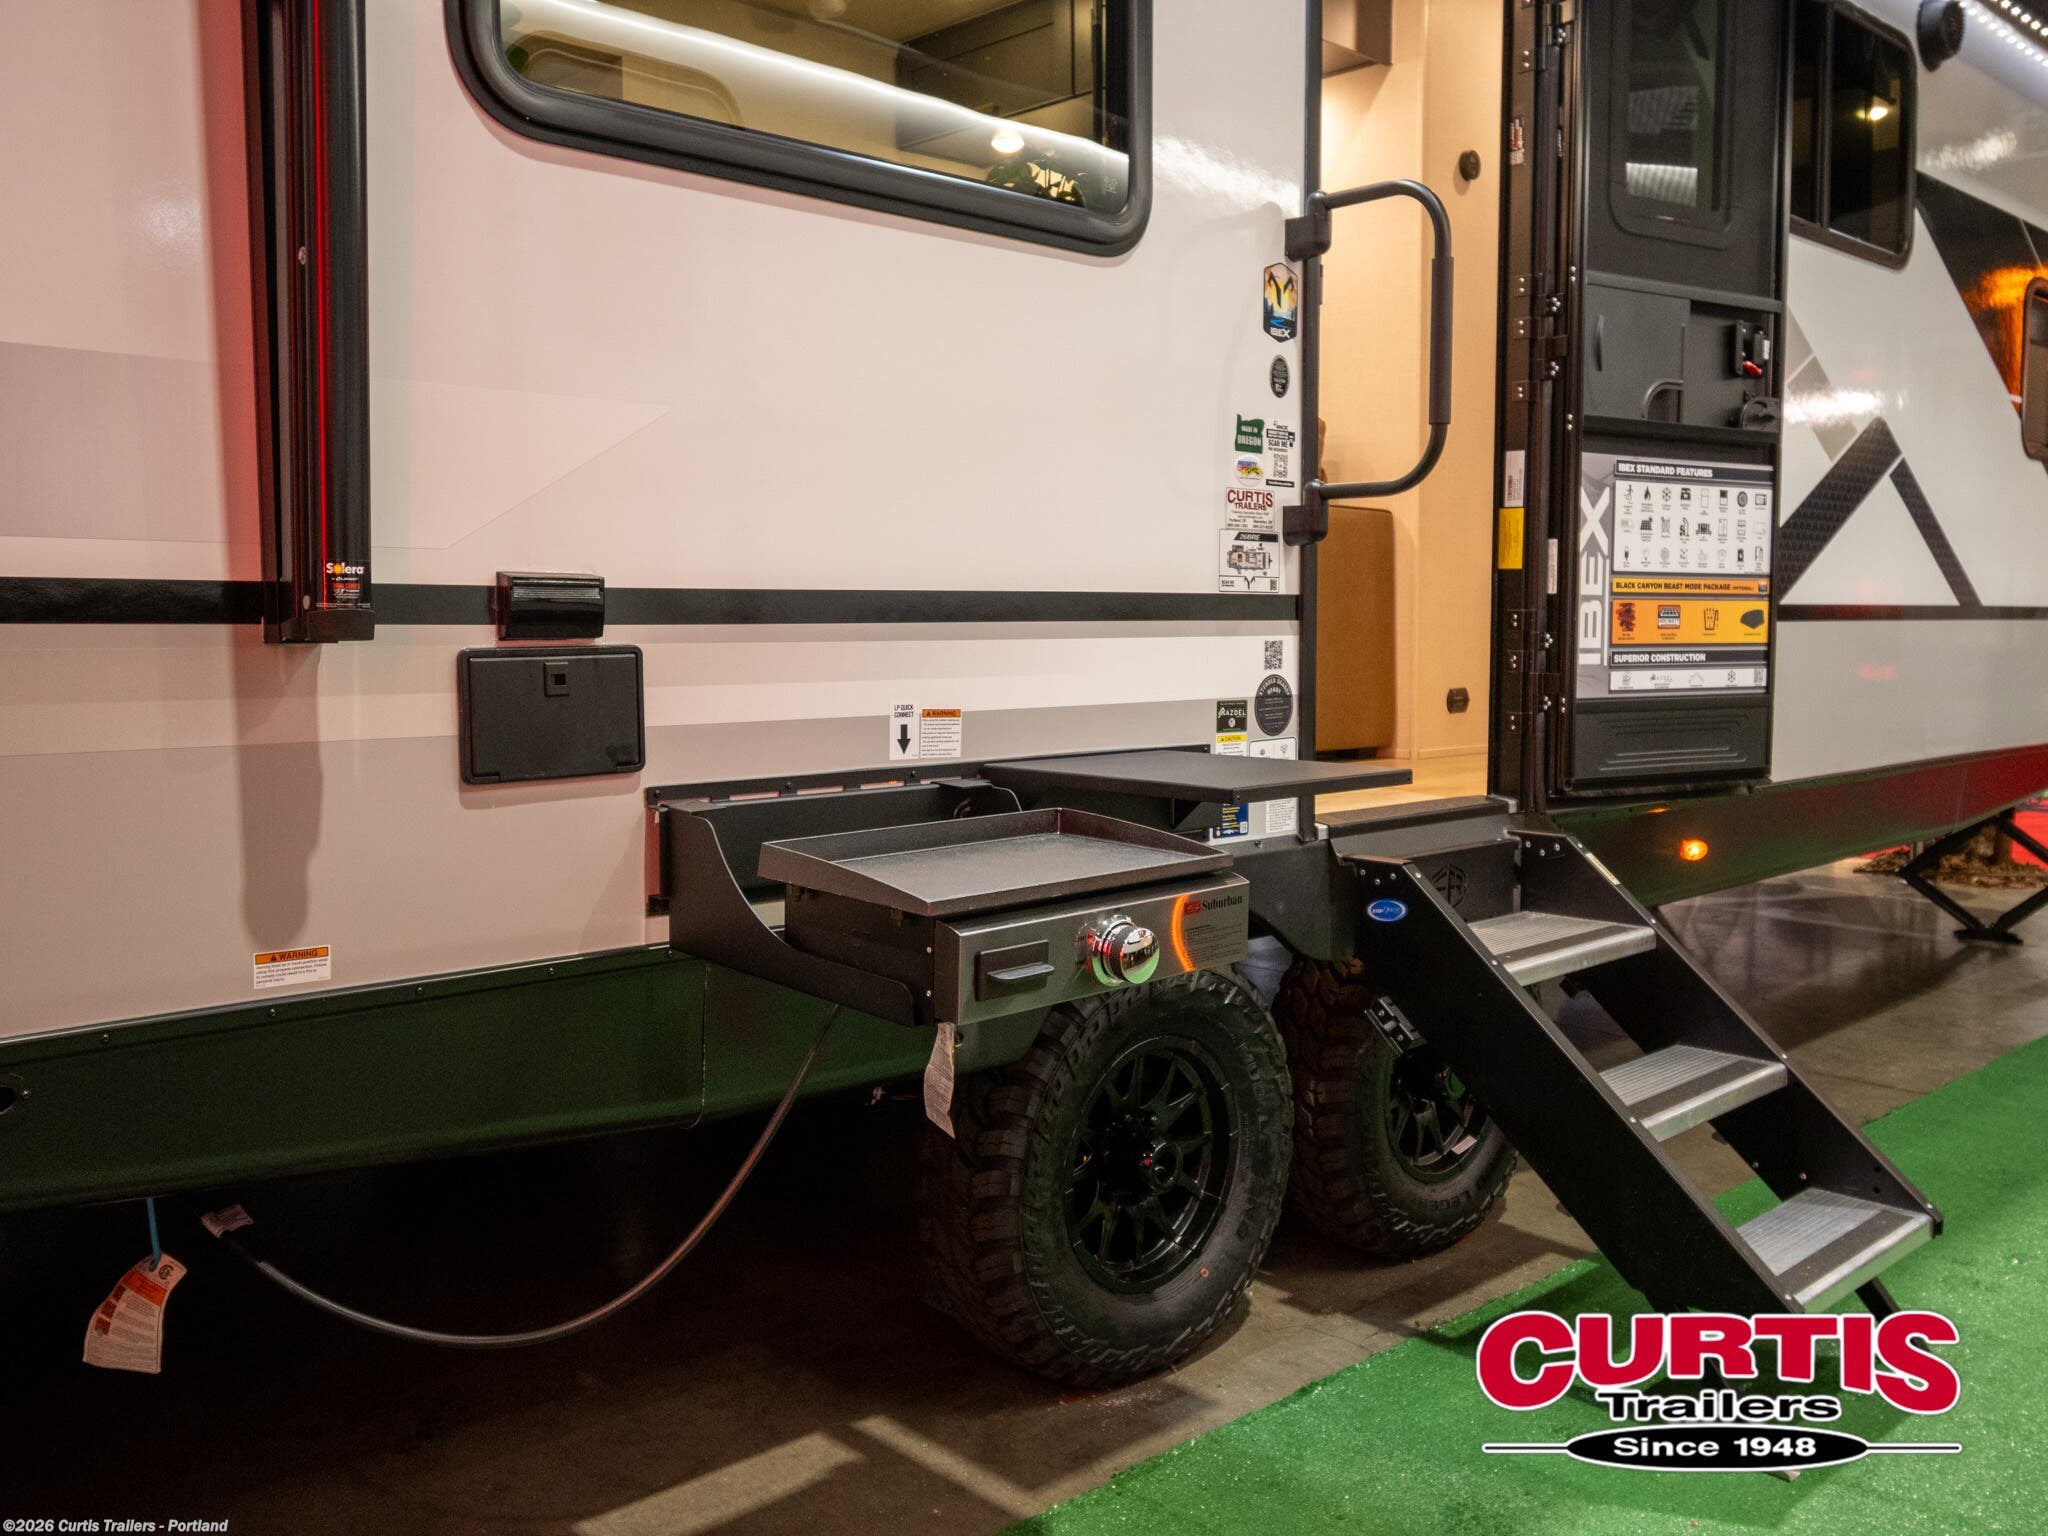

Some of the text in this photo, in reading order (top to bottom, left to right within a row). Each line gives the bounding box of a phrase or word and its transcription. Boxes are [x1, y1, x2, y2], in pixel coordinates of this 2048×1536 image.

[1237, 434, 1262, 446] OREGON
[1268, 439, 1289, 448] SCAN ME
[1618, 462, 1714, 478] IBEX STANDARD FEATURES
[1227, 489, 1273, 508] CURTIS
[1234, 501, 1267, 511] TRAILERS
[326, 562, 365, 574] Solera
[1577, 485, 1609, 666] IBEX
[1616, 581, 1635, 589] BLACK
[1637, 582, 1662, 590] CANYON
[1663, 582, 1683, 590] BEAST
[1703, 583, 1731, 591] PACKAGE
[1614, 652, 1706, 664] SUPERIOR CONSTRUCTION
[1203, 895, 1243, 911] Suburban
[279, 949, 318, 961] WARNING
